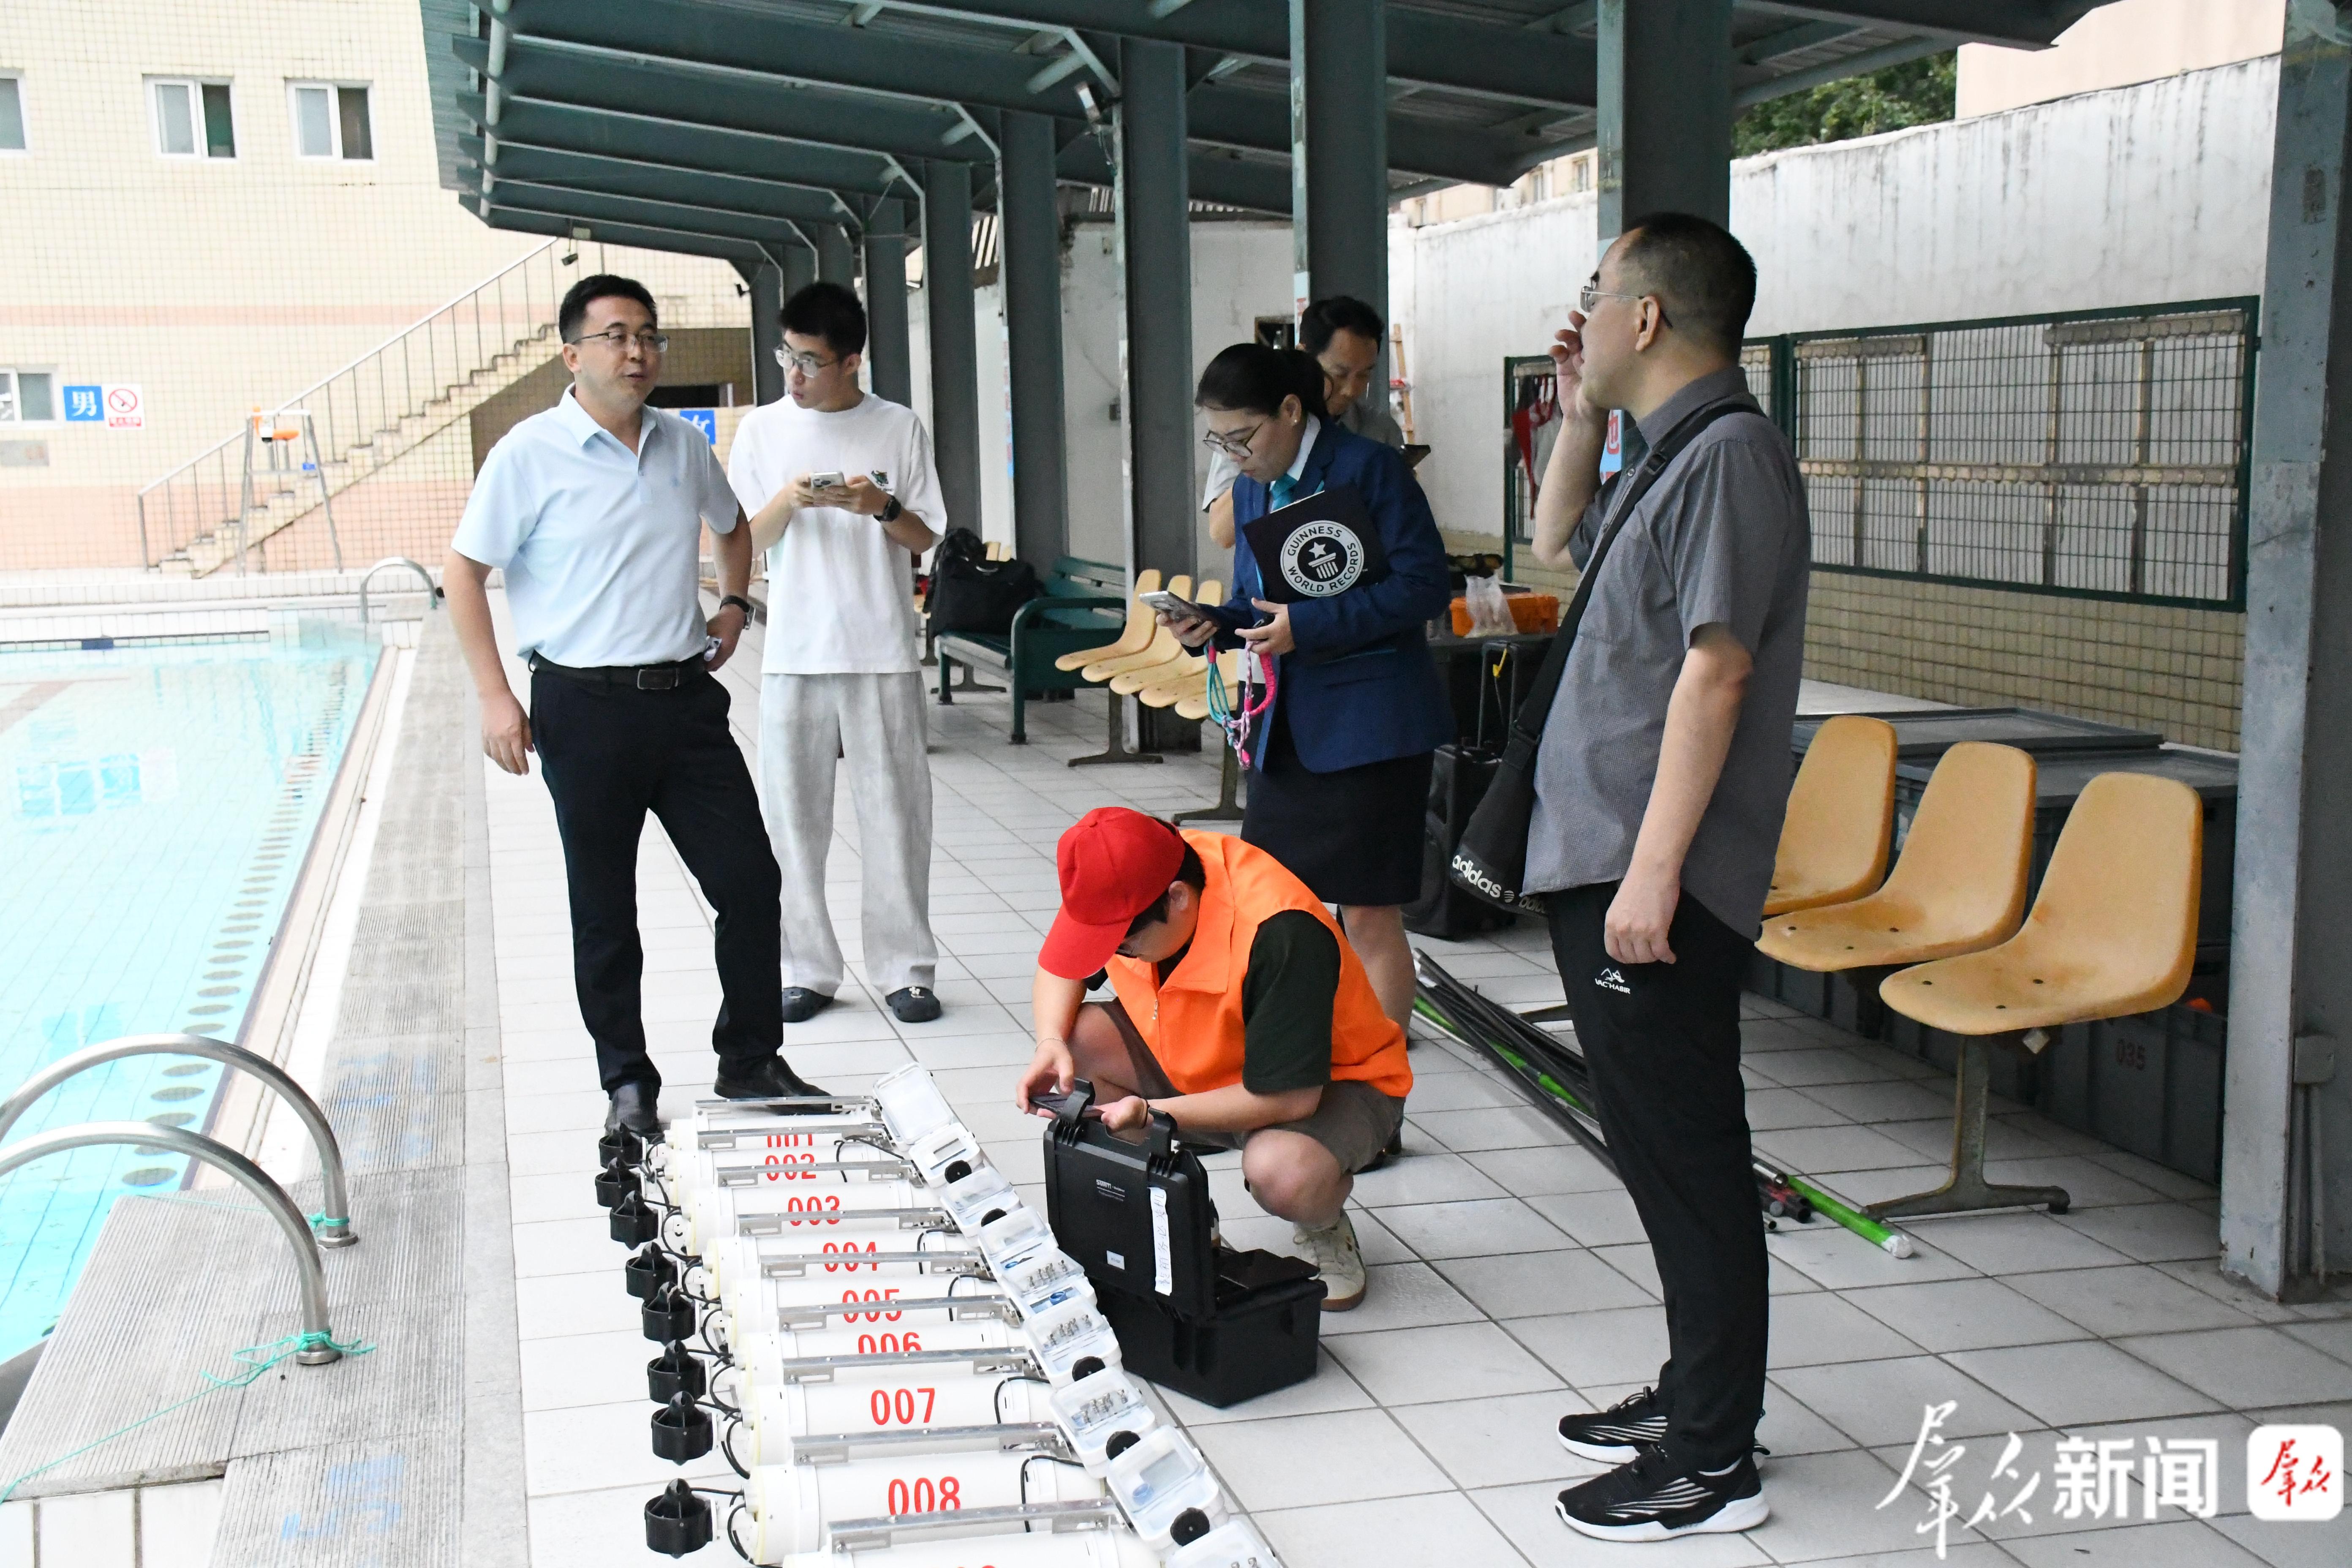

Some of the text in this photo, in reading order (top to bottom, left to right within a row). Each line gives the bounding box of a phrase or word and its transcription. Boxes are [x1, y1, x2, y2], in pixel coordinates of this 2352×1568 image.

[72, 390, 97, 417] 男
[1287, 525, 1343, 556] GUINNESS
[1288, 542, 1359, 592] WORLD RECORDS
[1452, 855, 1502, 898] adidas
[765, 1153, 816, 1181] 002
[788, 1195, 840, 1226] 003
[823, 1241, 878, 1272] 004
[842, 1289, 901, 1323] 005
[858, 1332, 923, 1354] 006
[871, 1388, 935, 1425] 007
[888, 1476, 961, 1516] 008
